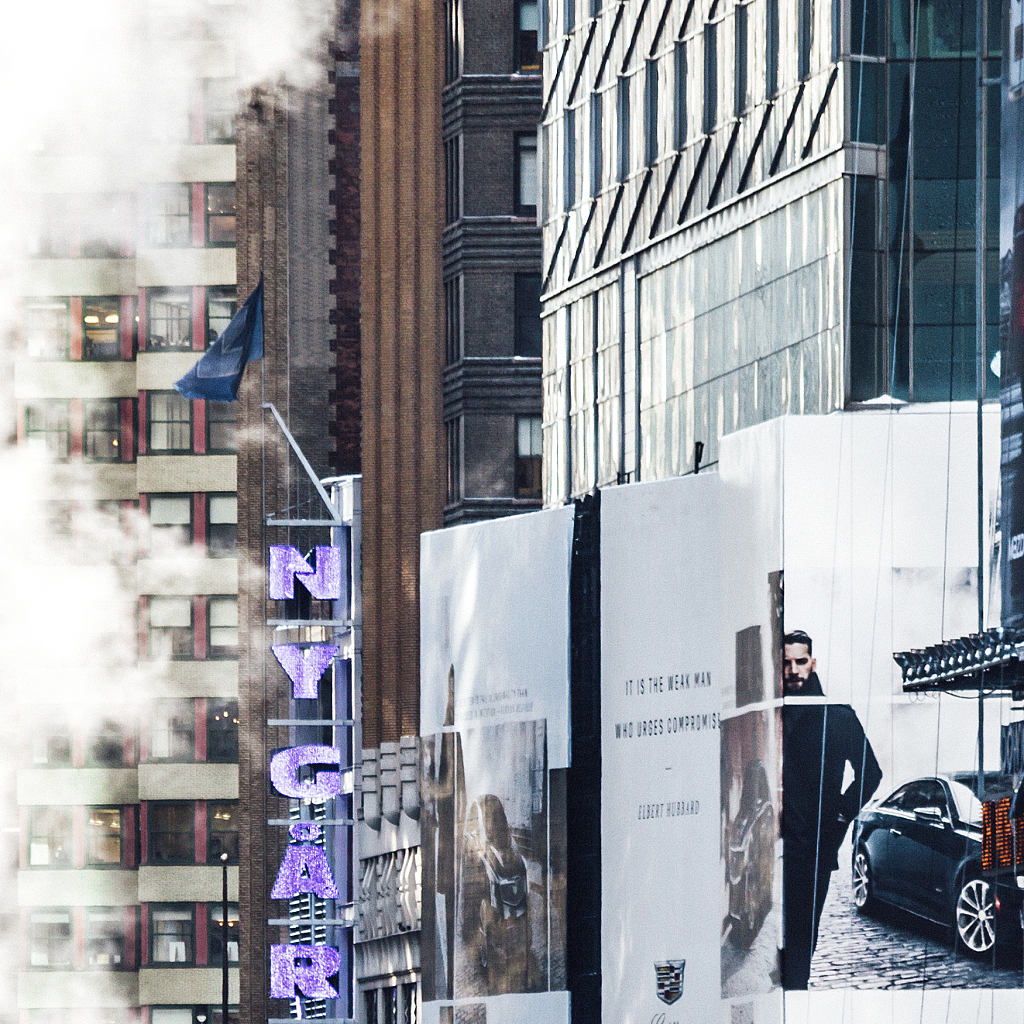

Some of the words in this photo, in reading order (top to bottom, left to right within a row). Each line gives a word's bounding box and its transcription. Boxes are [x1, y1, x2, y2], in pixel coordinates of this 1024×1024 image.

[637, 679, 644, 694] IS
[649, 676, 663, 692] THE
[667, 674, 690, 690] WEAK
[694, 671, 711, 687] MAN
[615, 722, 633, 738] WHO
[637, 719, 664, 737] URGES
[666, 800, 699, 817] HUBBARD
